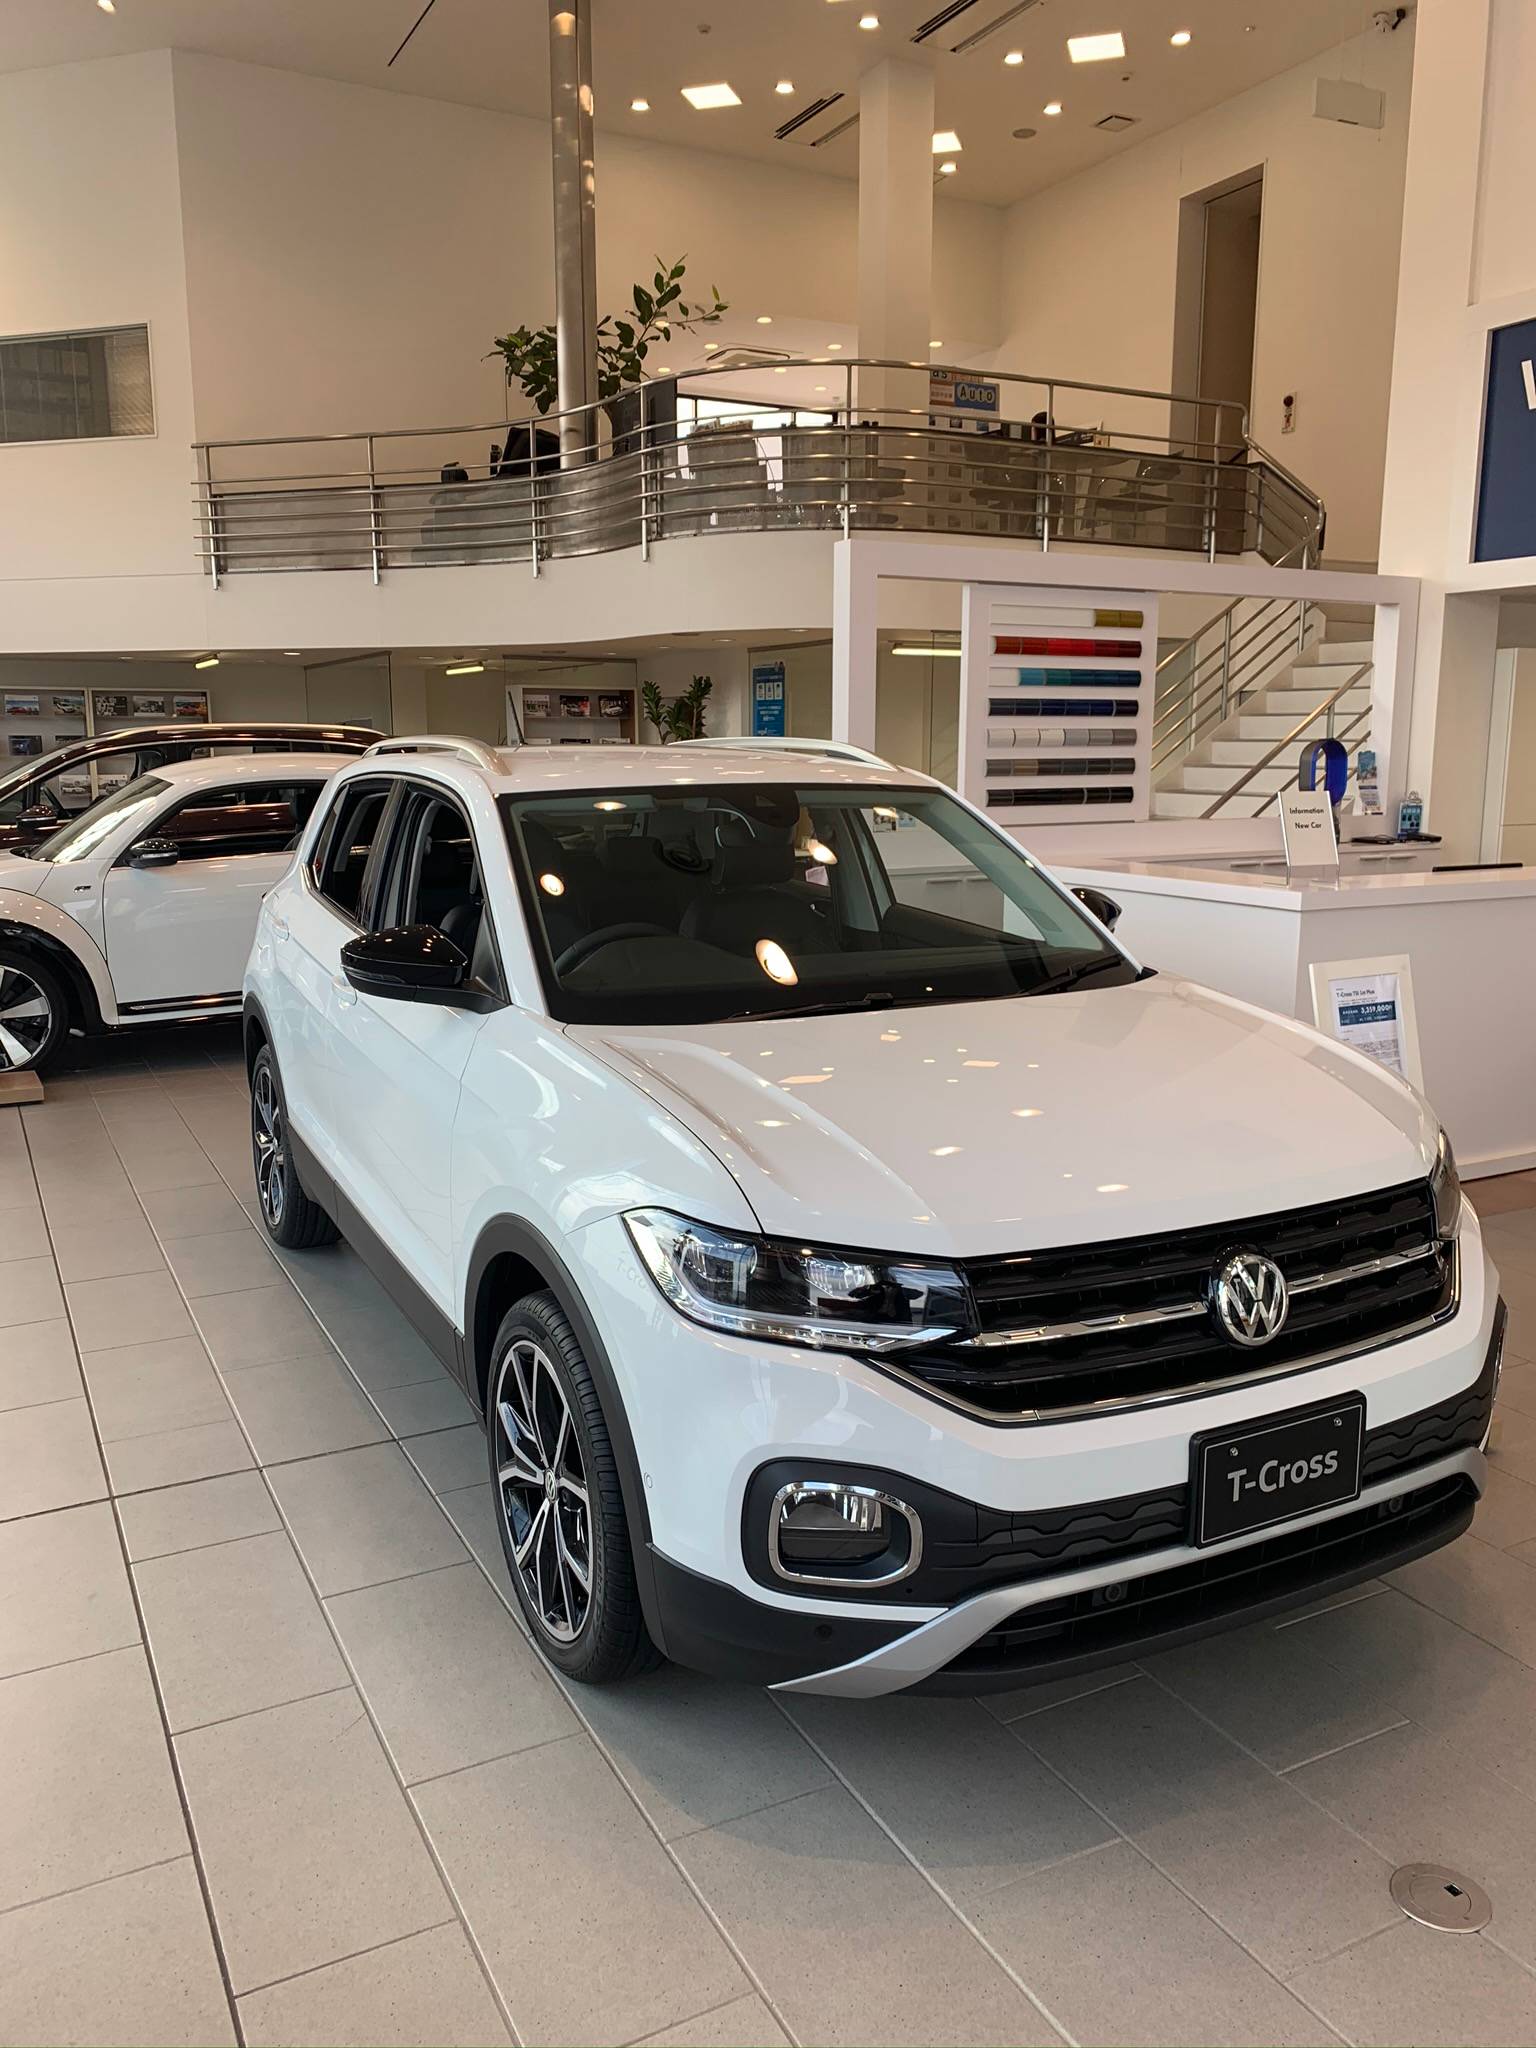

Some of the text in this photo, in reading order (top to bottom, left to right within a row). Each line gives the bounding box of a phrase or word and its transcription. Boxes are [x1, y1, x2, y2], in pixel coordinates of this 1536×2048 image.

[960, 385, 993, 402] Auto
[1311, 821, 1322, 829] Car
[1227, 1450, 1338, 1502] T-Cross
